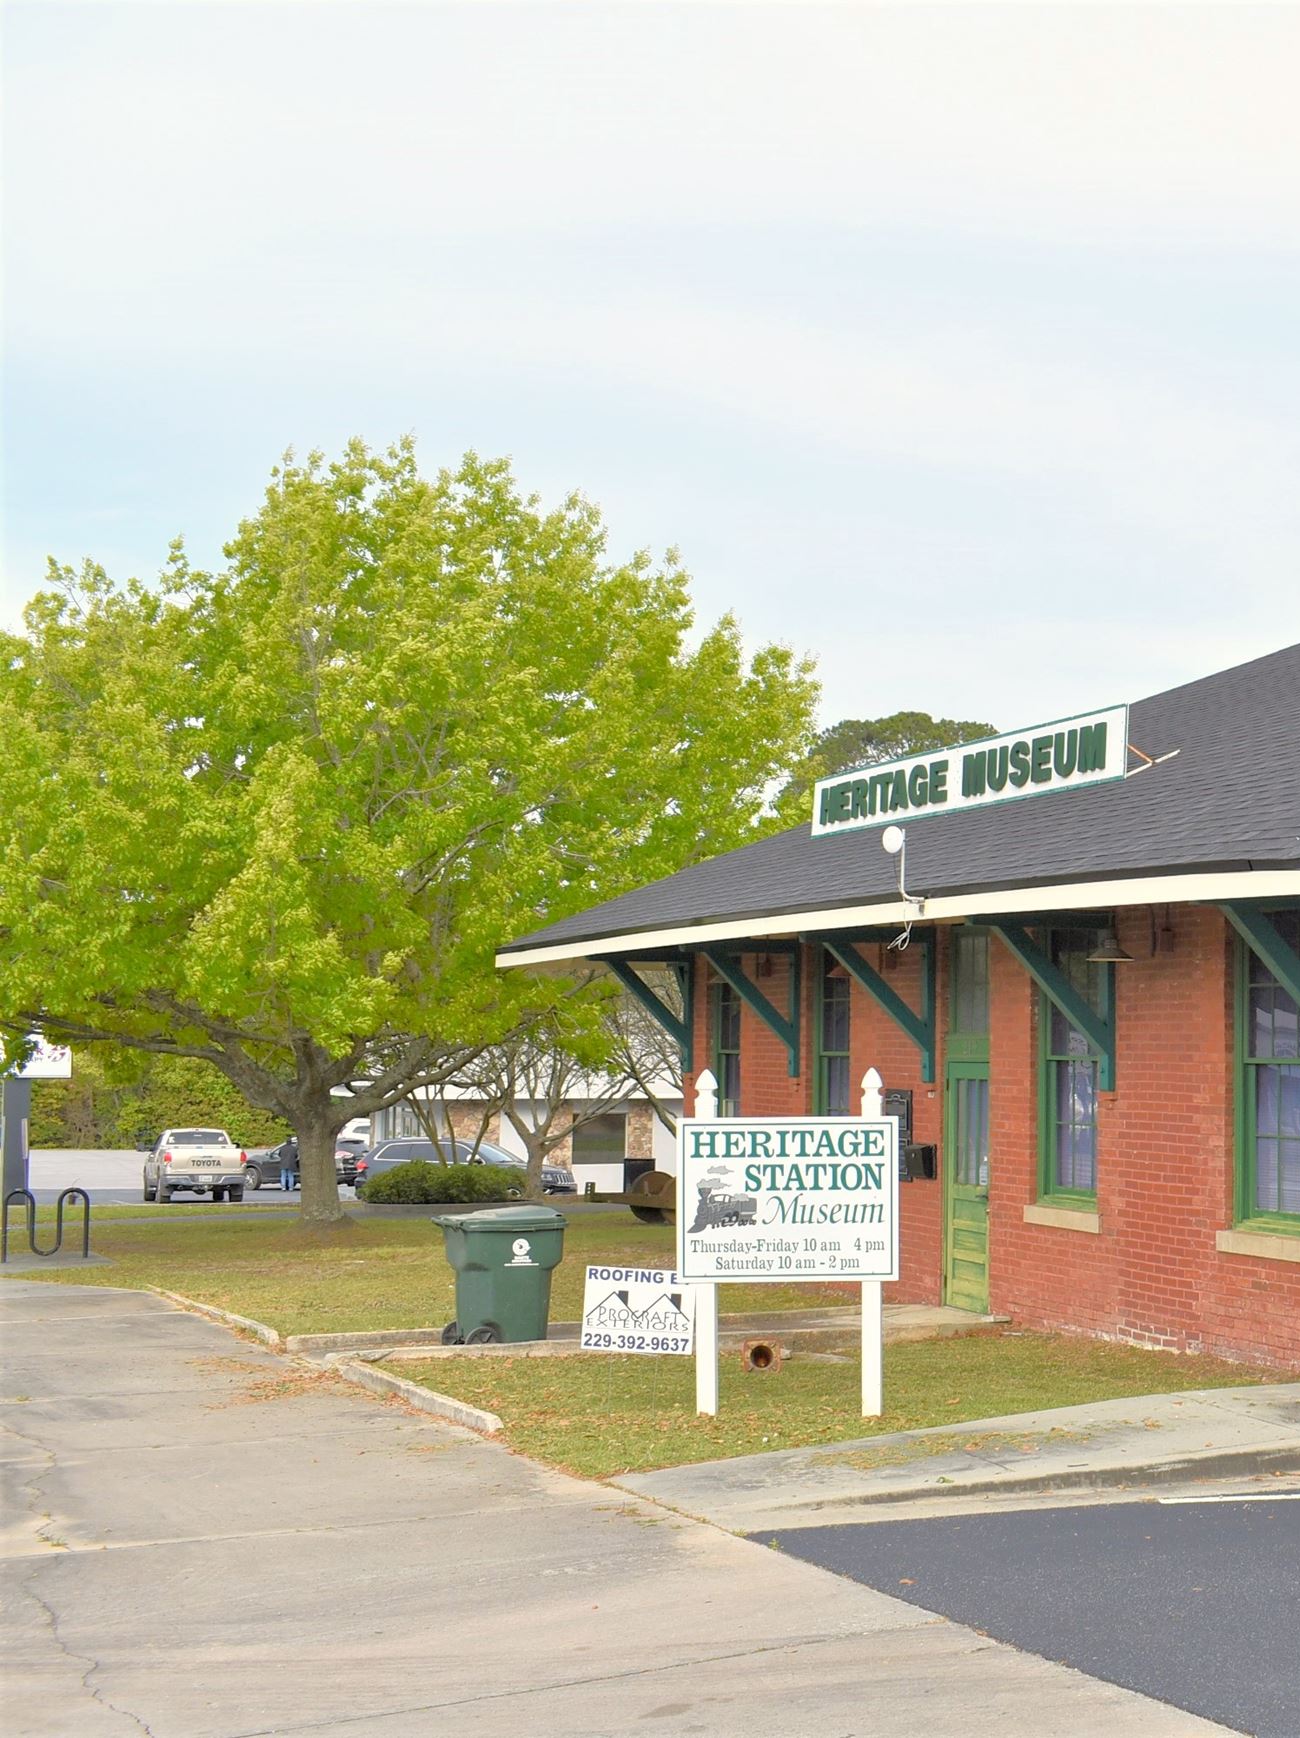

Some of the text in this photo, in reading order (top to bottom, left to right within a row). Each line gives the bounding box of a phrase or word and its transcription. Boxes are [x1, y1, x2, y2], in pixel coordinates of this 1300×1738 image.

[820, 721, 1107, 826] HERITAGE MUSEUM
[690, 1130, 885, 1158] HERITAGE
[191, 1159, 221, 1167] TOYOTA
[745, 1163, 885, 1192] STATION
[762, 1193, 885, 1225] Museum
[690, 1237, 885, 1254] Thursday-Friday 10 am 4 pm
[715, 1256, 774, 1271] Saturday
[778, 1256, 792, 1269] 10
[795, 1258, 816, 1268] am
[829, 1255, 837, 1268] 2
[840, 1258, 860, 1270] pm
[588, 1268, 664, 1284] ROOFING
[586, 1317, 689, 1331] EXTERIORS
[599, 1306, 681, 1324] PROCRAFT
[584, 1333, 689, 1351] 229-392-9637
